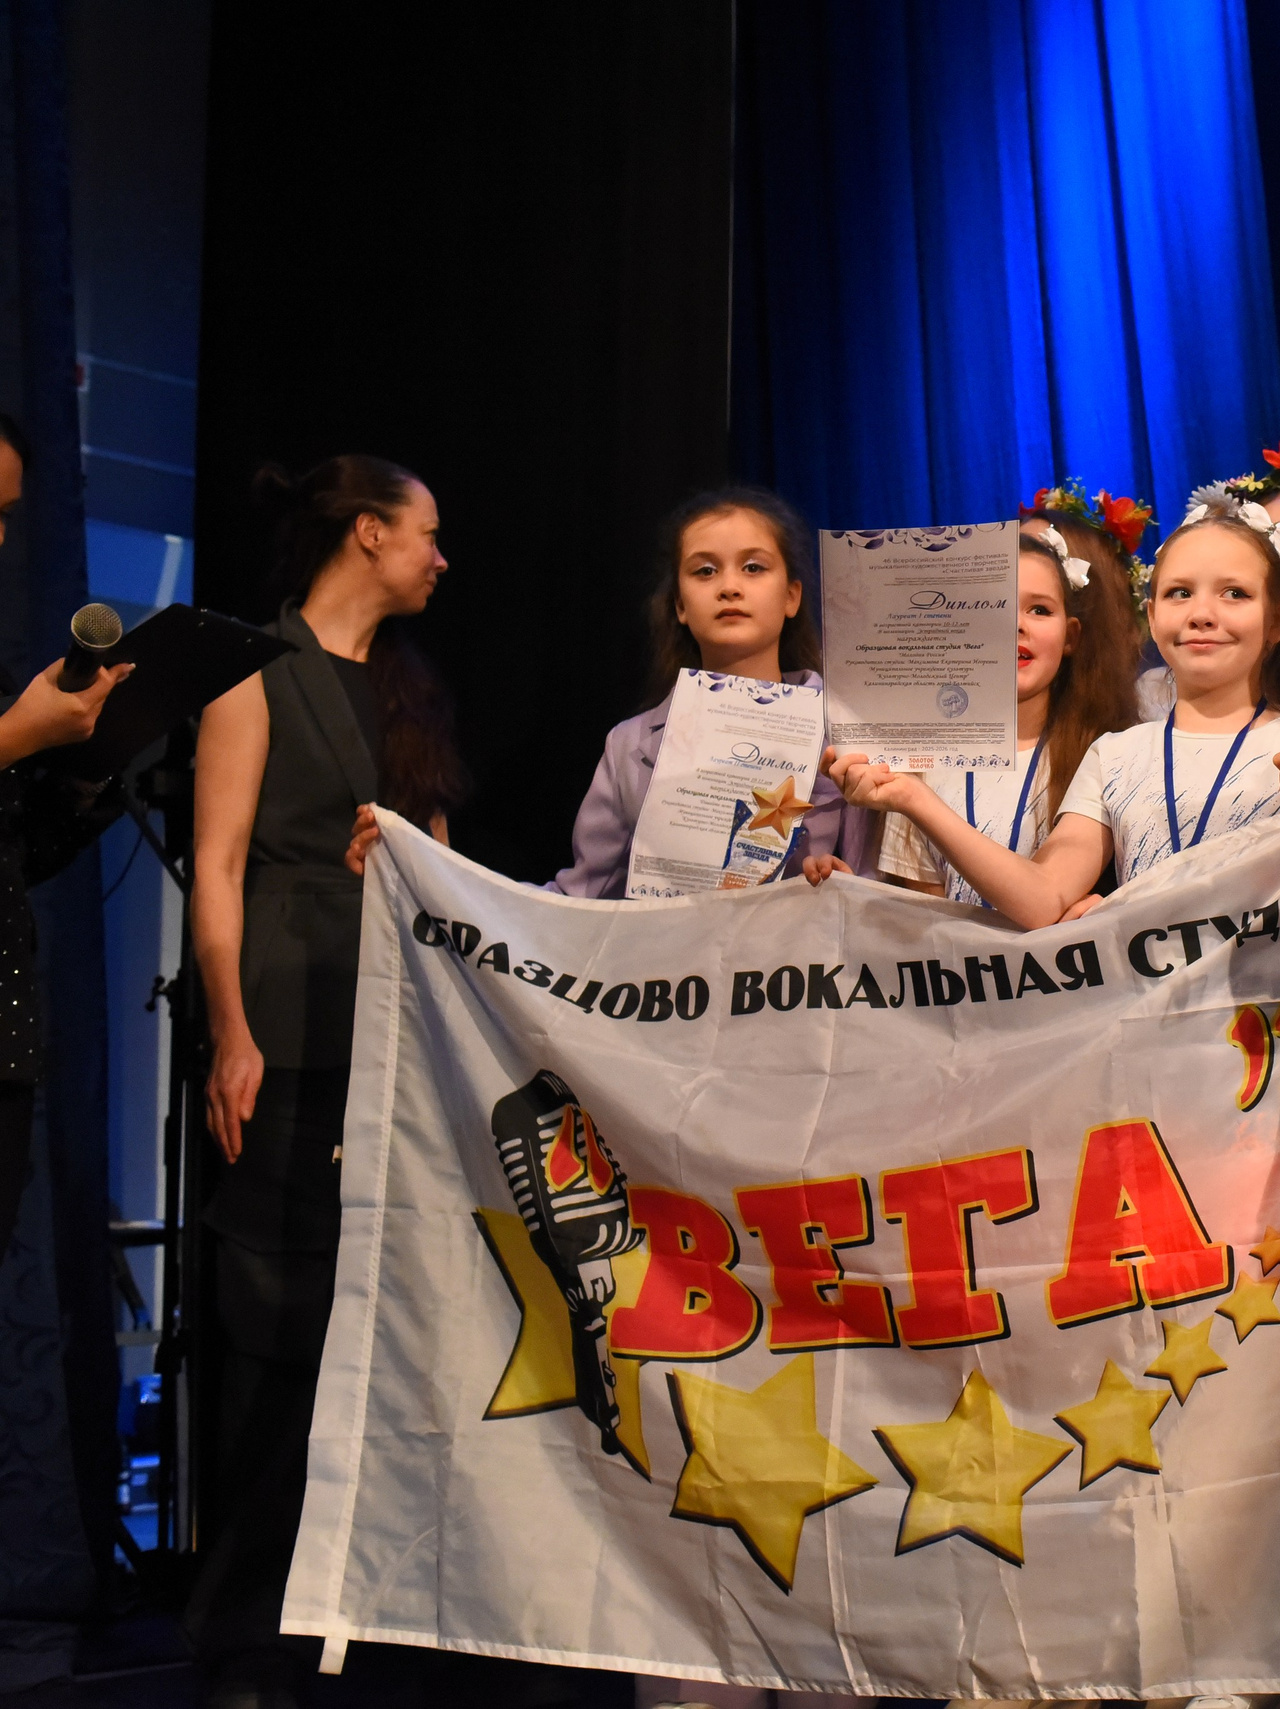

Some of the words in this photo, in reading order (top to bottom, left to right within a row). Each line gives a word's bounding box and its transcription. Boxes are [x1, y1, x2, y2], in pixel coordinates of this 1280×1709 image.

[908, 590, 1006, 610] Диплом
[855, 643, 897, 652] Образцовая
[935, 642, 961, 651] студия
[728, 741, 807, 773] Диплом
[736, 842, 783, 860] СЧАСТЛИВАЯ
[743, 850, 770, 863] ЗВЕЗДА
[730, 940, 1105, 1016] ВОКАЛЬНАЯ
